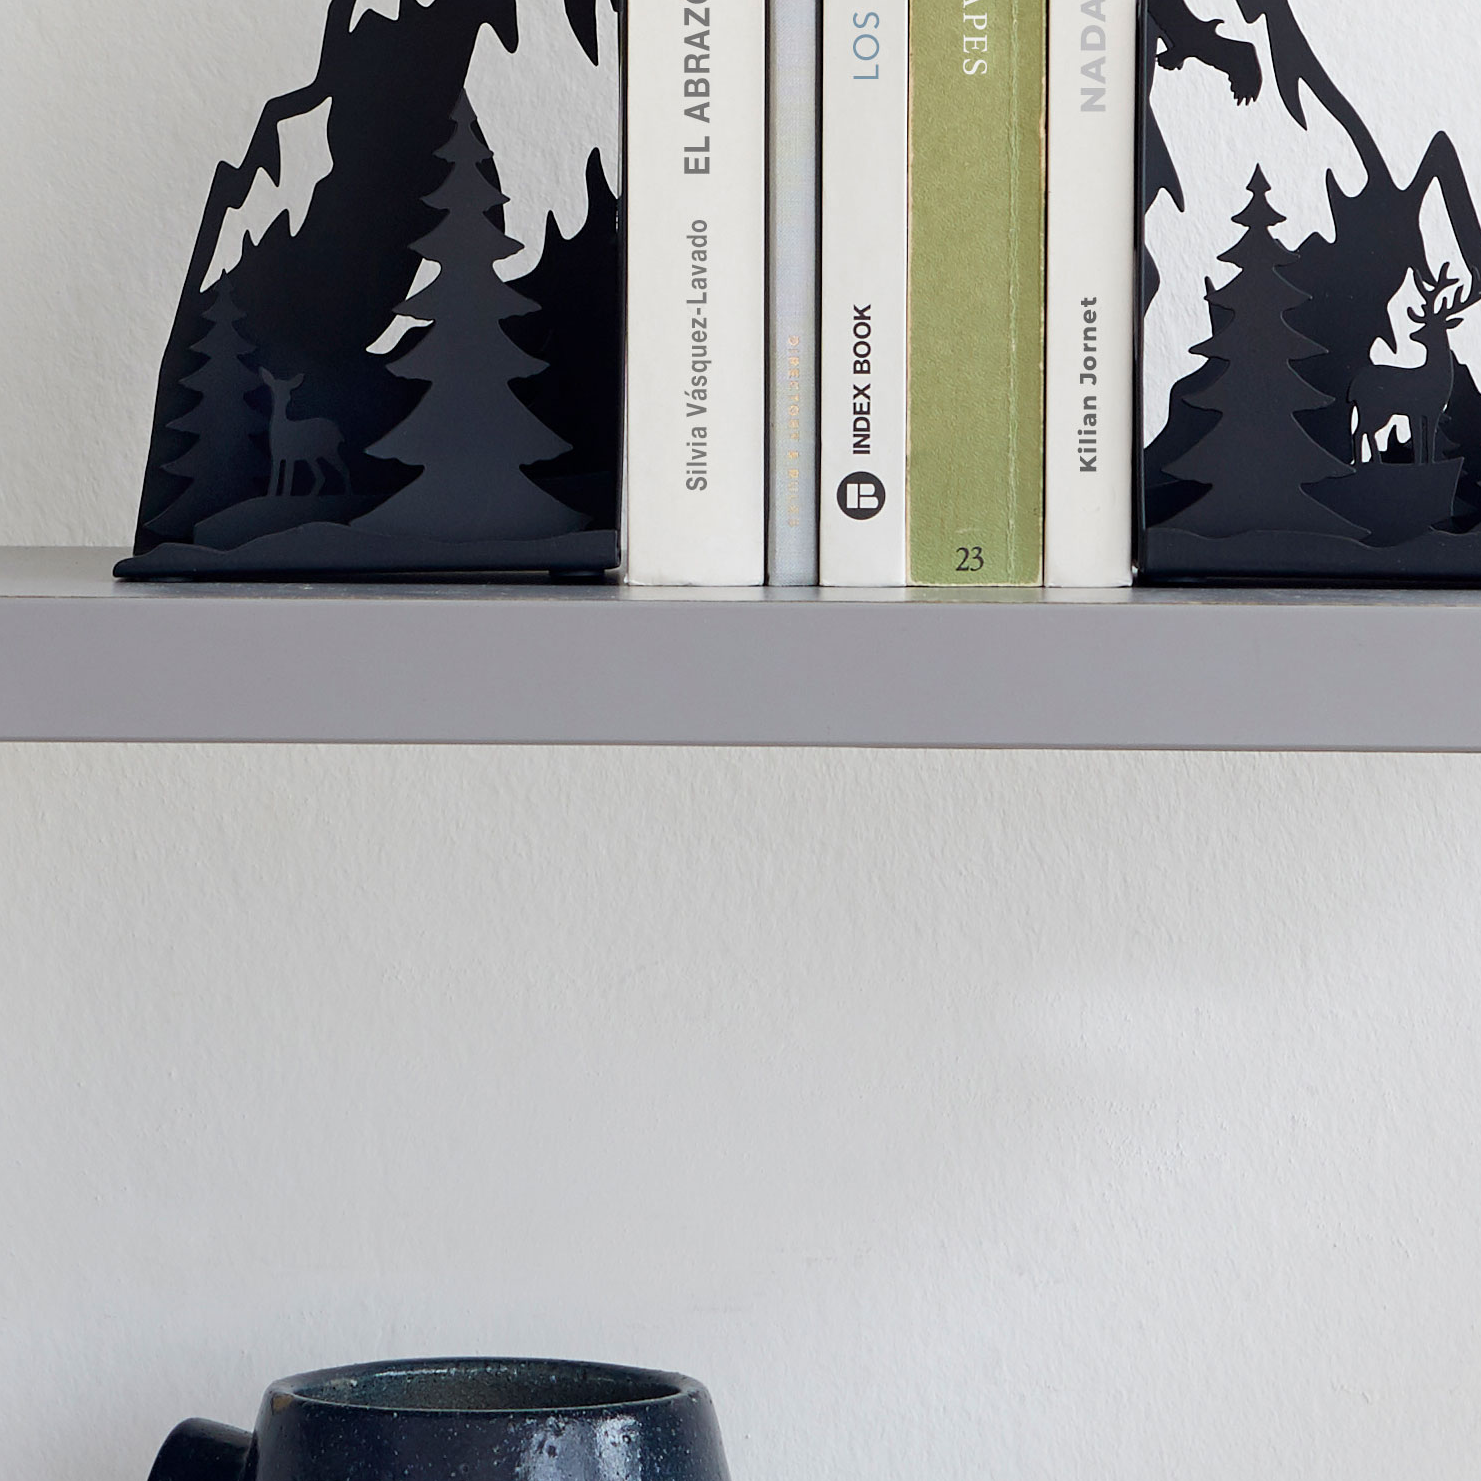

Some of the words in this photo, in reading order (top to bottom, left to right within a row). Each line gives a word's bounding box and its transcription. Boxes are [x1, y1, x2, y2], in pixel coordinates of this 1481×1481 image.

[852, 11, 881, 80] LOS
[683, 135, 711, 175] EL
[684, 219, 712, 418] Vásquez-Lavado
[852, 303, 872, 375] BOOK
[1079, 296, 1098, 386] Jornet
[852, 382, 872, 456] INDEX
[1077, 395, 1098, 473] Kilian
[685, 426, 708, 492] Silvia
[955, 546, 985, 572] 23
